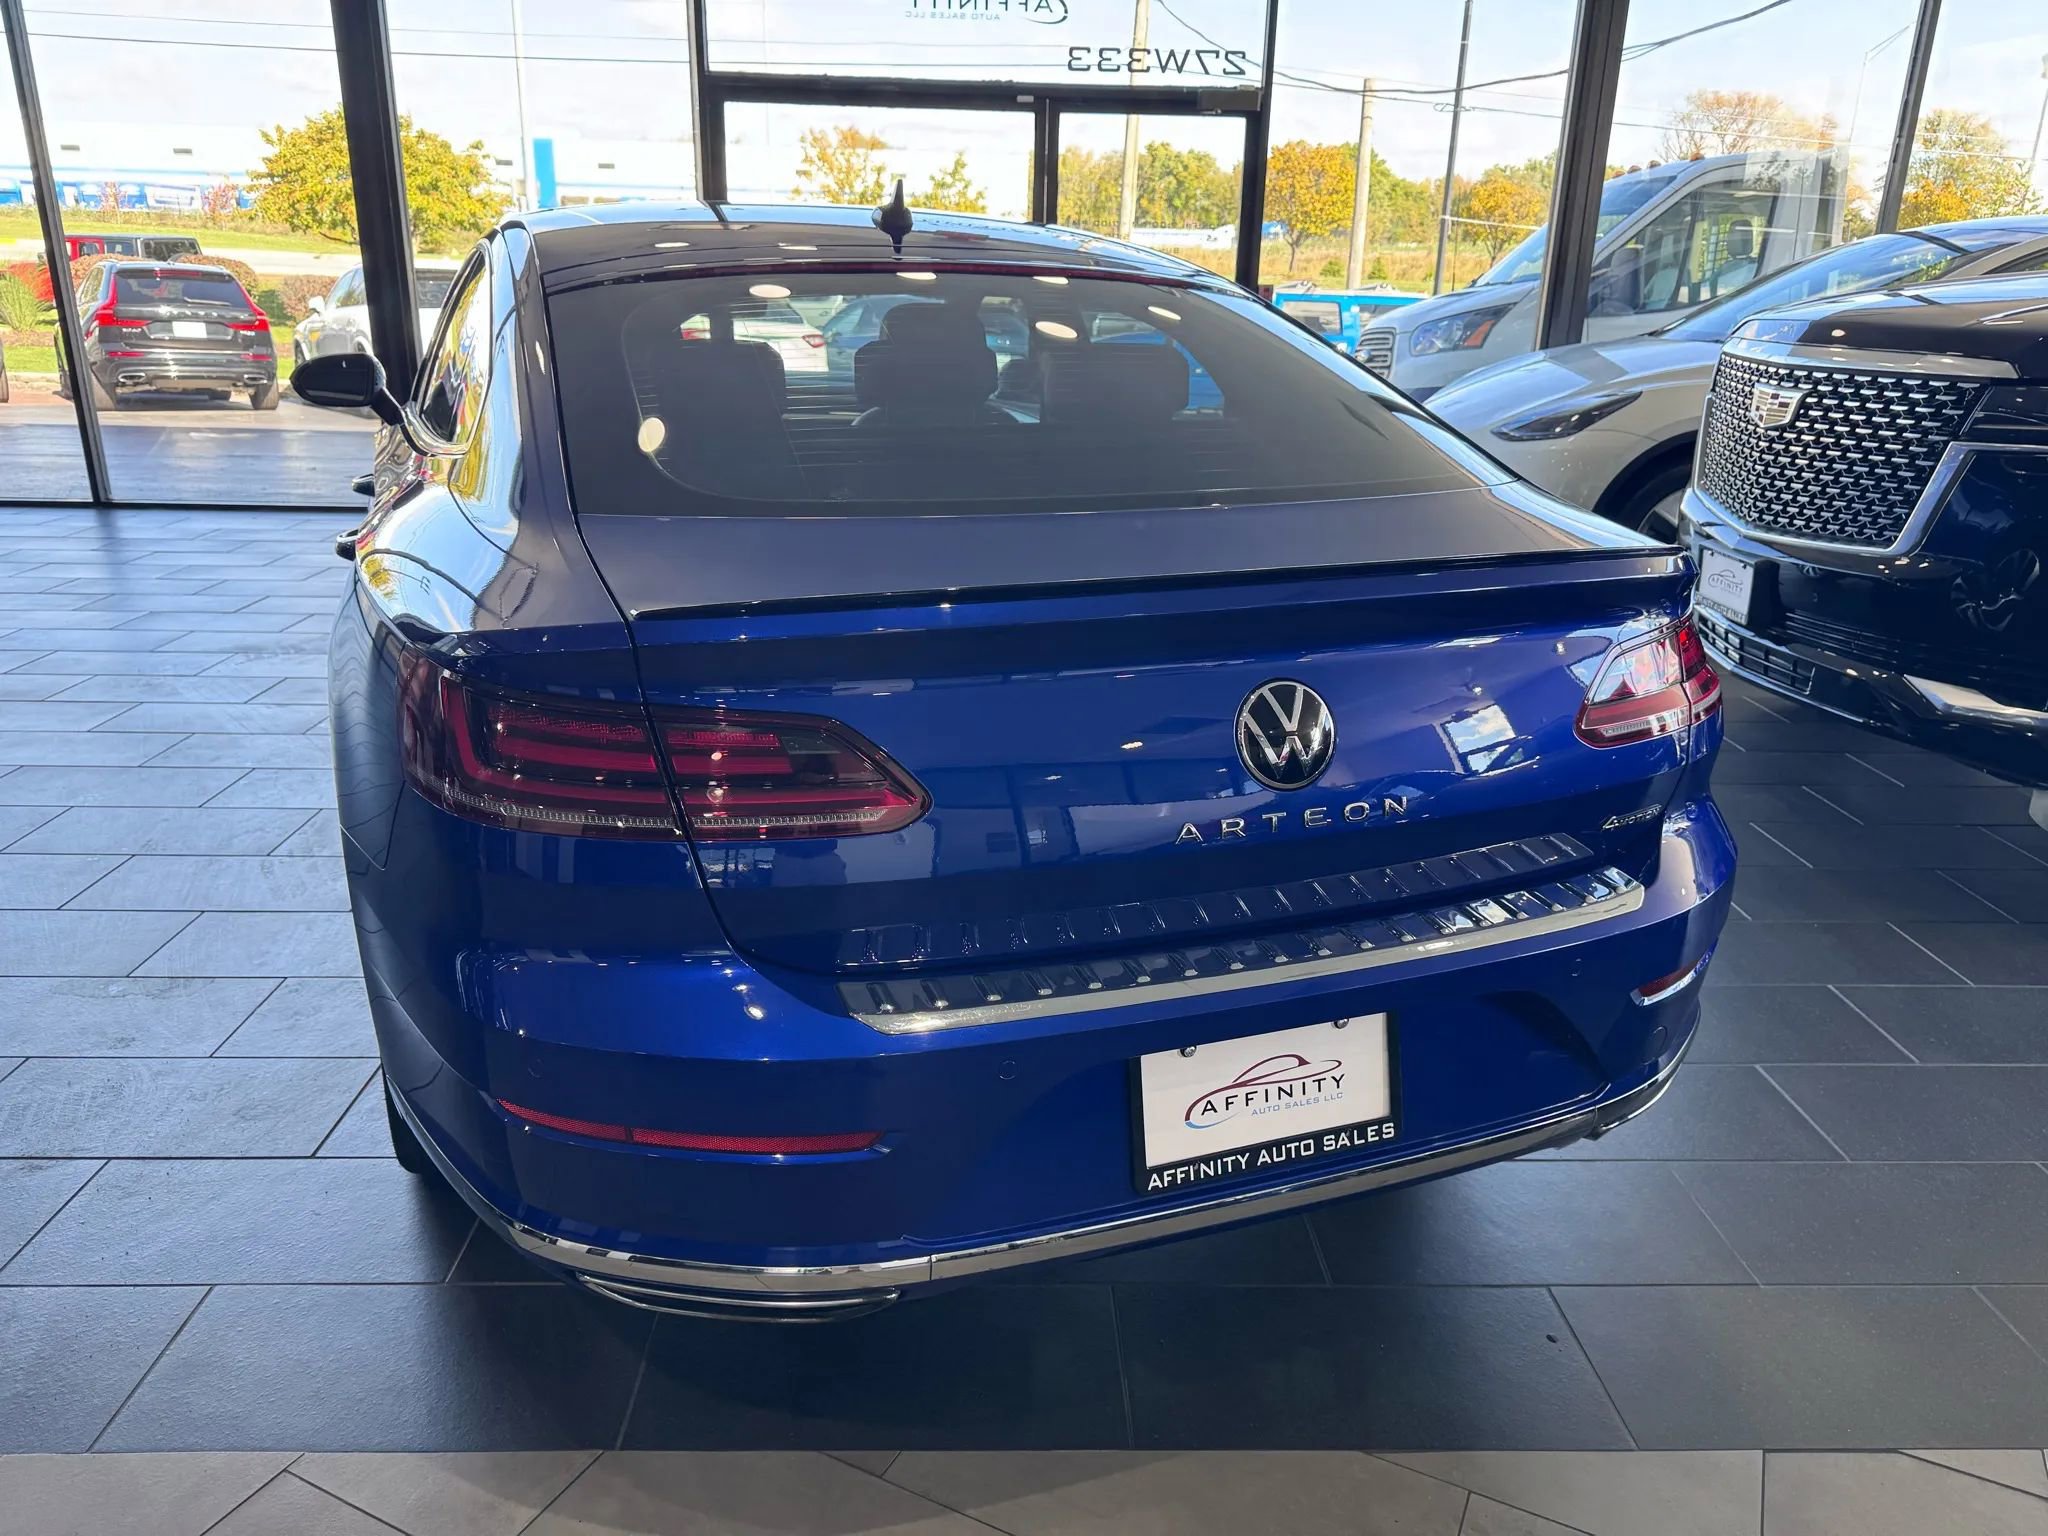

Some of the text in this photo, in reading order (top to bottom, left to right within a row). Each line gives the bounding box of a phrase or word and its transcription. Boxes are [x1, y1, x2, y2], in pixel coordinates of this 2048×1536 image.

[1175, 796, 1408, 845] ARTEON
[1201, 1074, 1345, 1116] AFFINITY
[1251, 1091, 1344, 1117] AUTO SALES LLC
[1147, 1122, 1395, 1191] AFFINITY AUTO SALES
